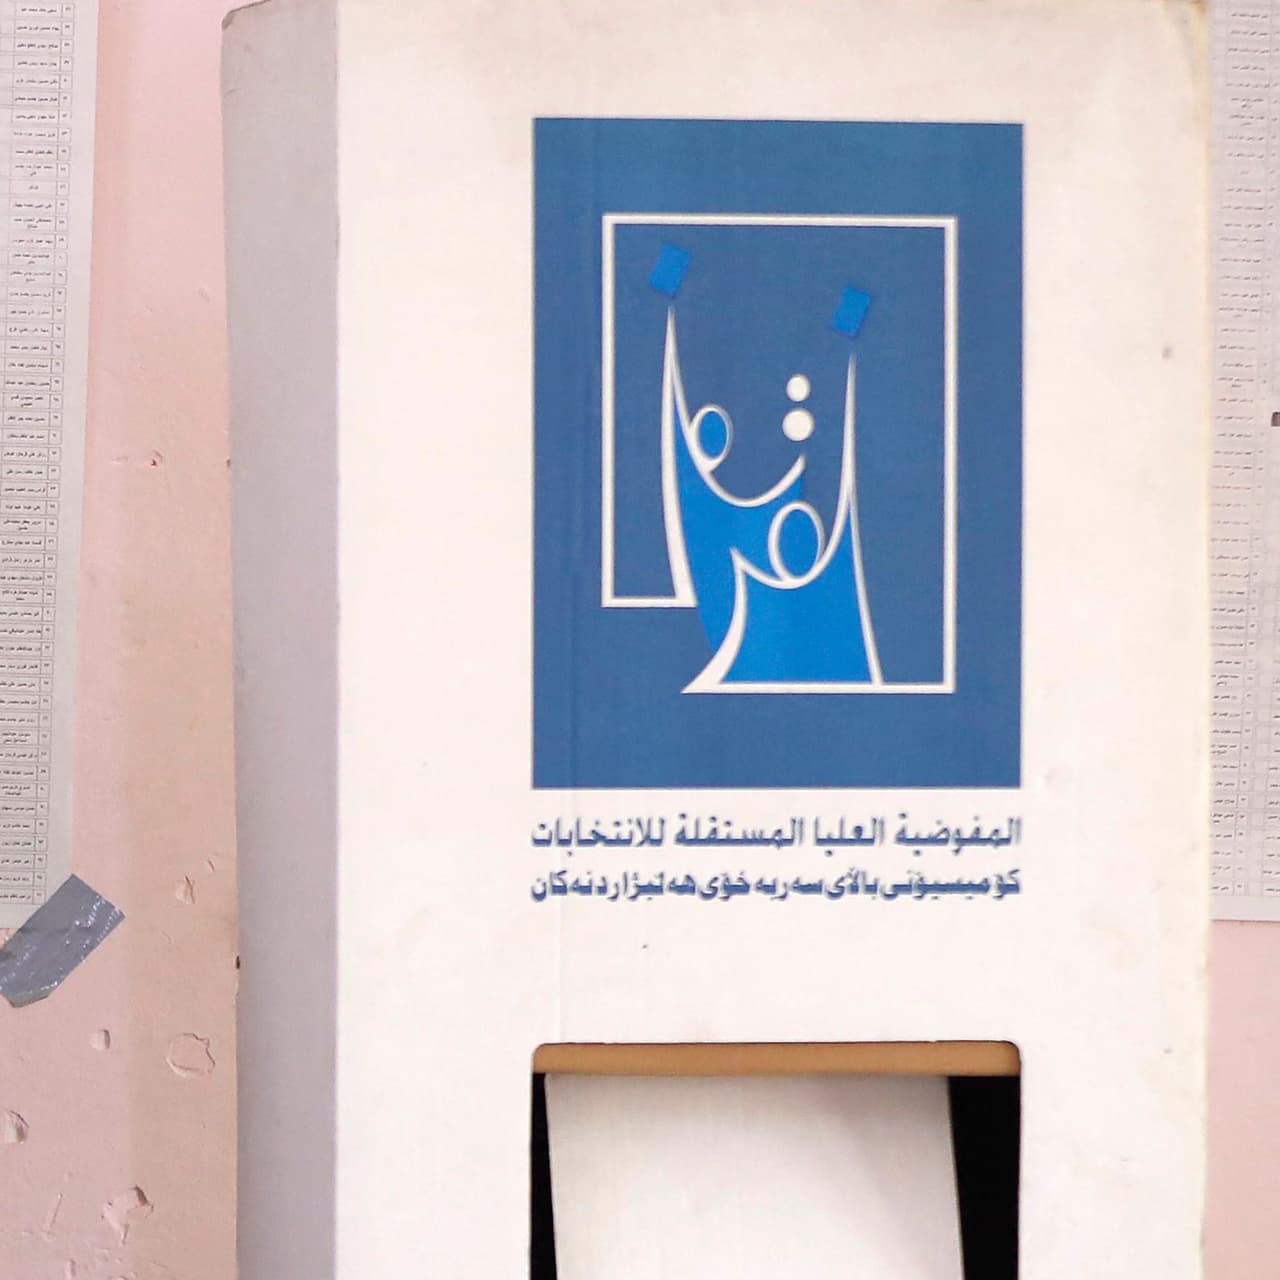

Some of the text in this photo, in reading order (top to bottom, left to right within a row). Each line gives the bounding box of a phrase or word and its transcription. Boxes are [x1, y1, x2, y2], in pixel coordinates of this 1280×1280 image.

[530, 812, 1022, 857] المفوضية العليا المستقلة للانتخابات
